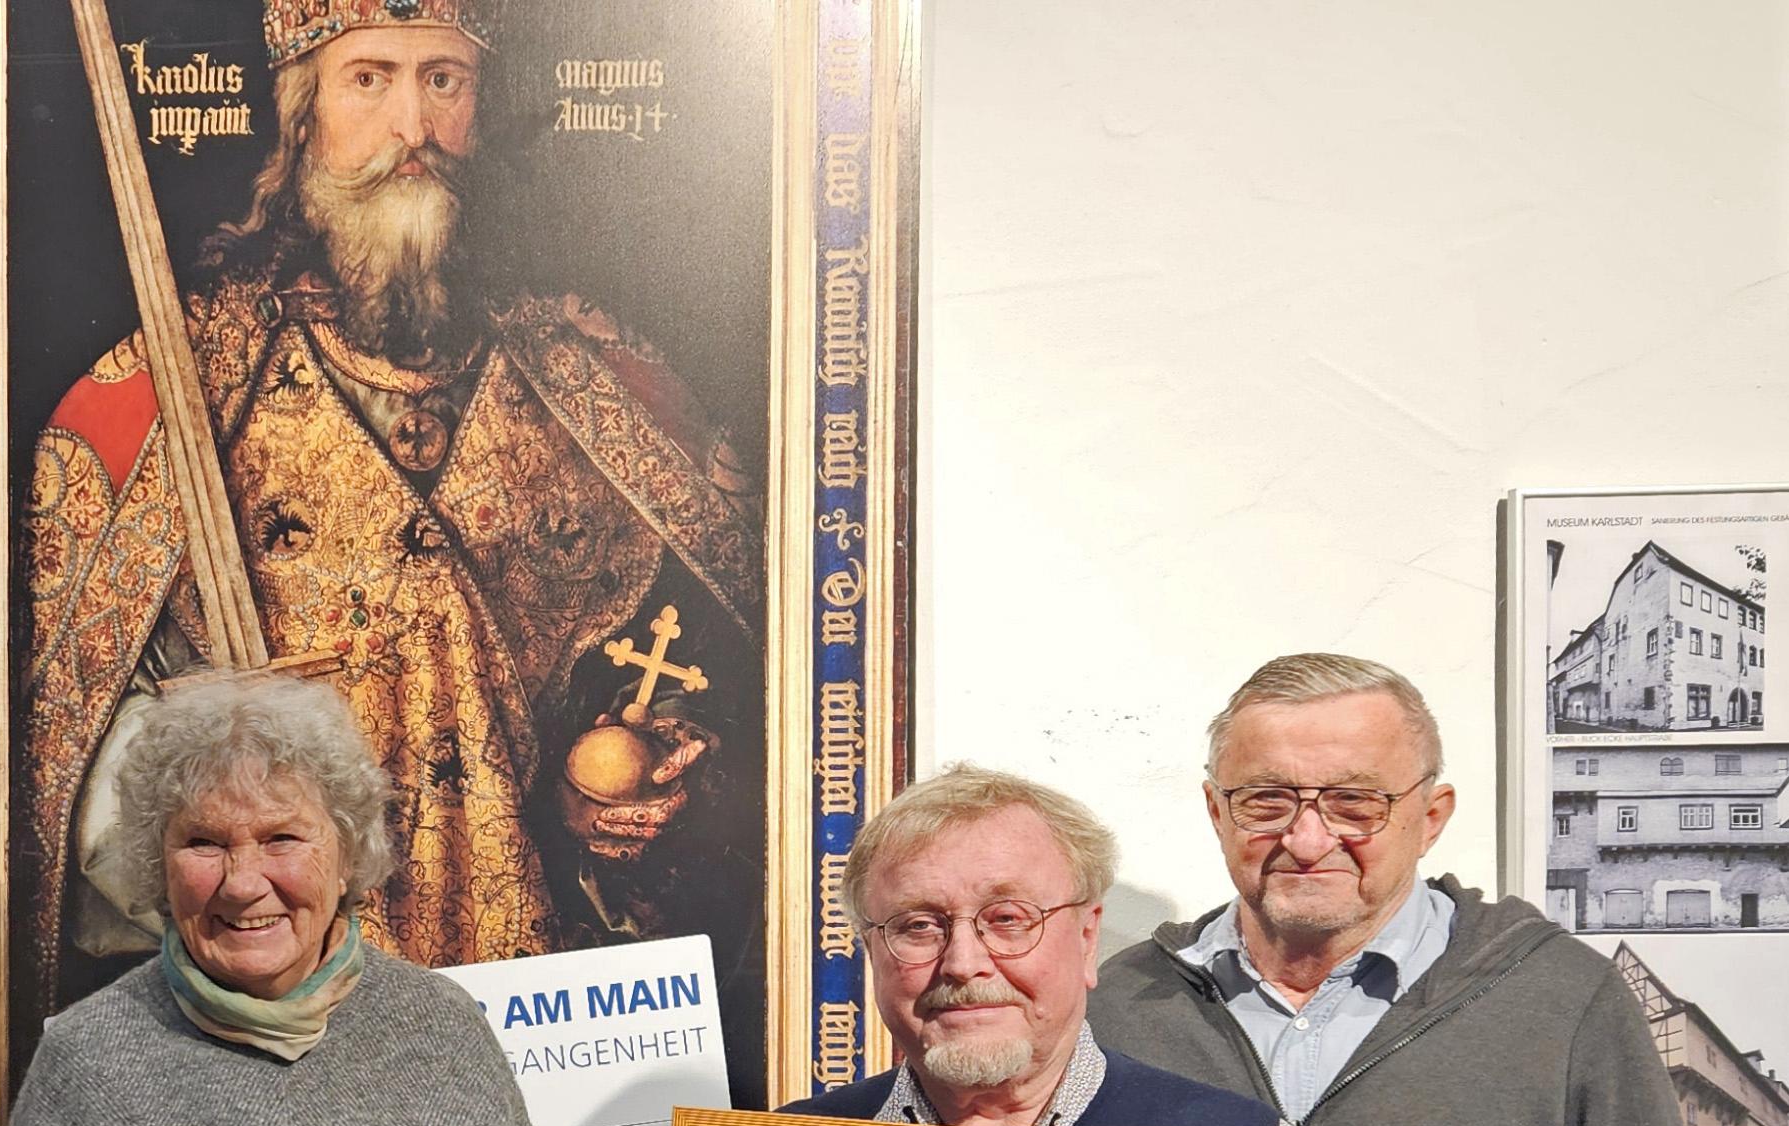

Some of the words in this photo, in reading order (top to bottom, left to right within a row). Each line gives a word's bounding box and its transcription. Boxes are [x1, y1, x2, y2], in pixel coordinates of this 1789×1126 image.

[1547, 518, 1589, 528] MUSEUM
[1591, 517, 1643, 527] KARLSTADT
[504, 989, 572, 1030] AM
[587, 972, 701, 1019] MAIN
